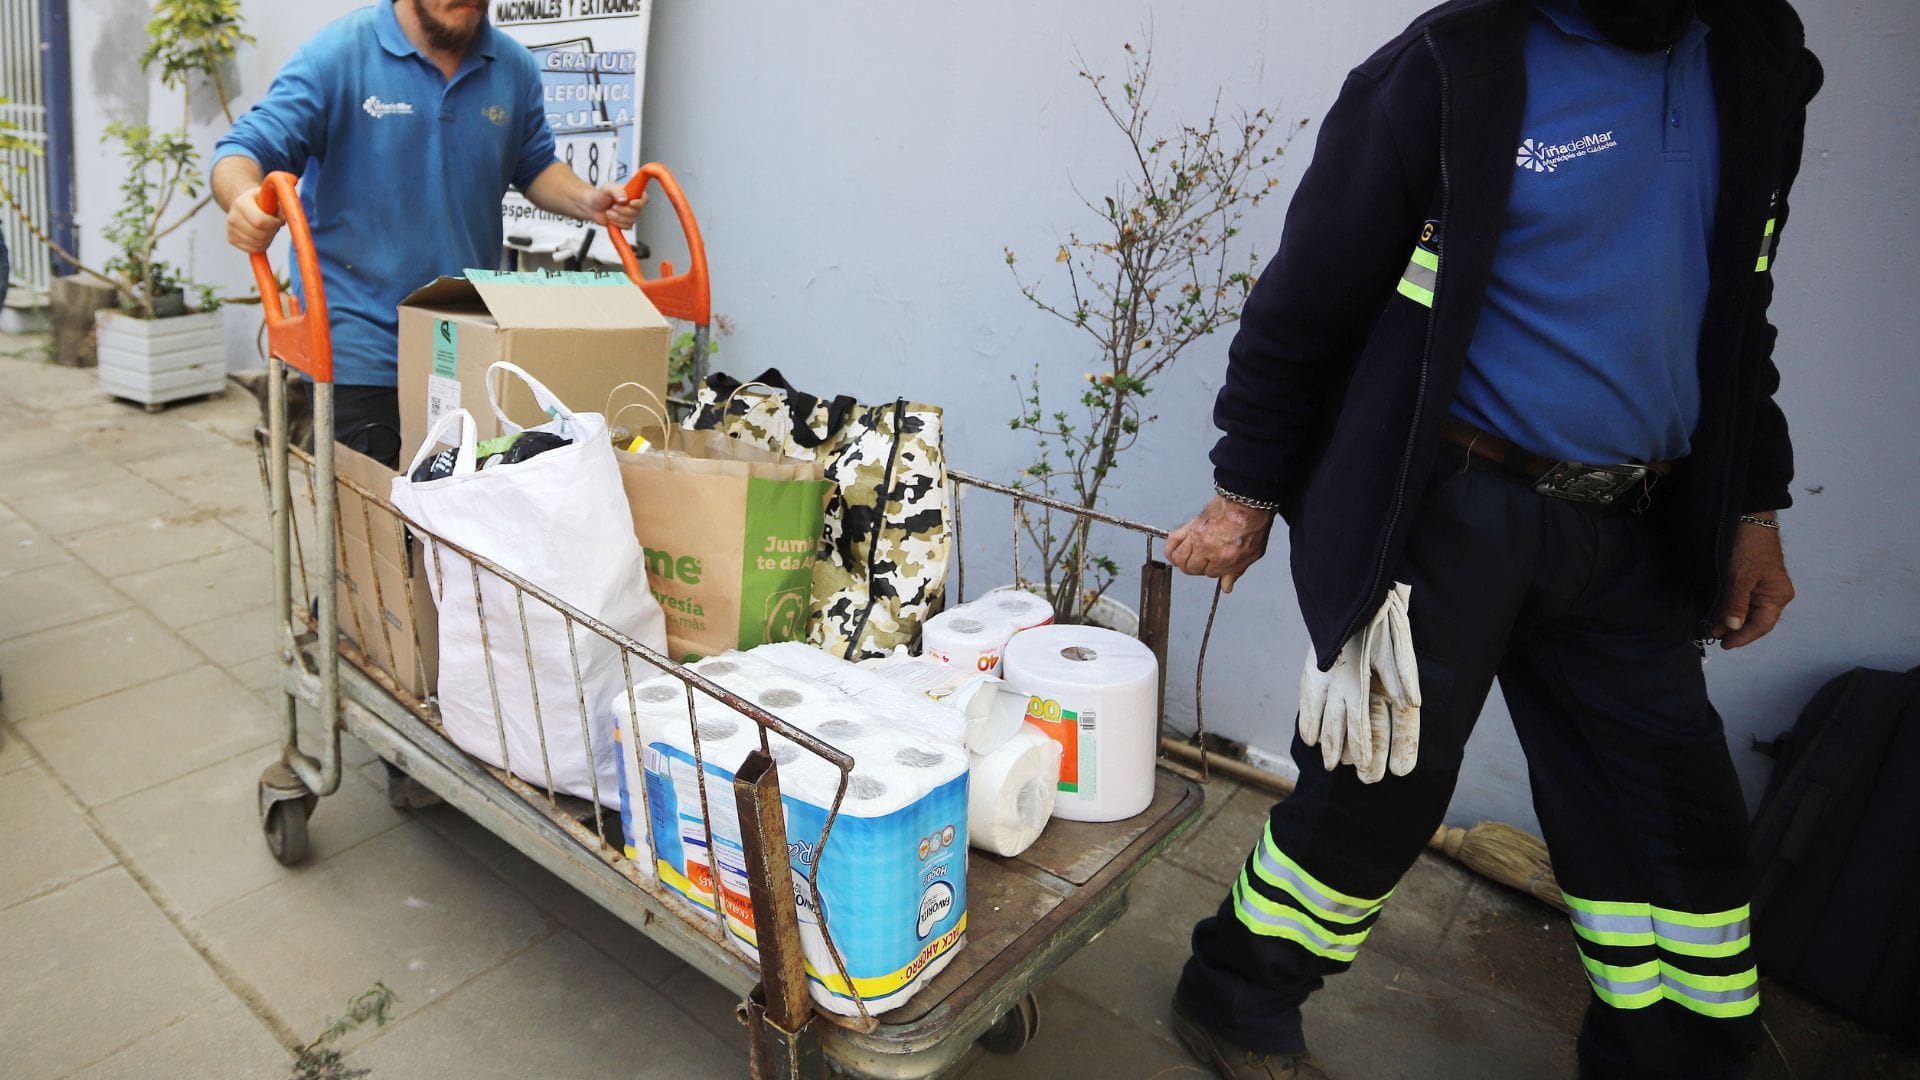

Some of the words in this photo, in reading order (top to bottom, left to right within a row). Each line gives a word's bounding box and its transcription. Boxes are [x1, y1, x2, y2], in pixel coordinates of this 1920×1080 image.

[756, 556, 776, 570] te
[780, 556, 800, 570] da
[920, 896, 951, 924] FAVORITA
